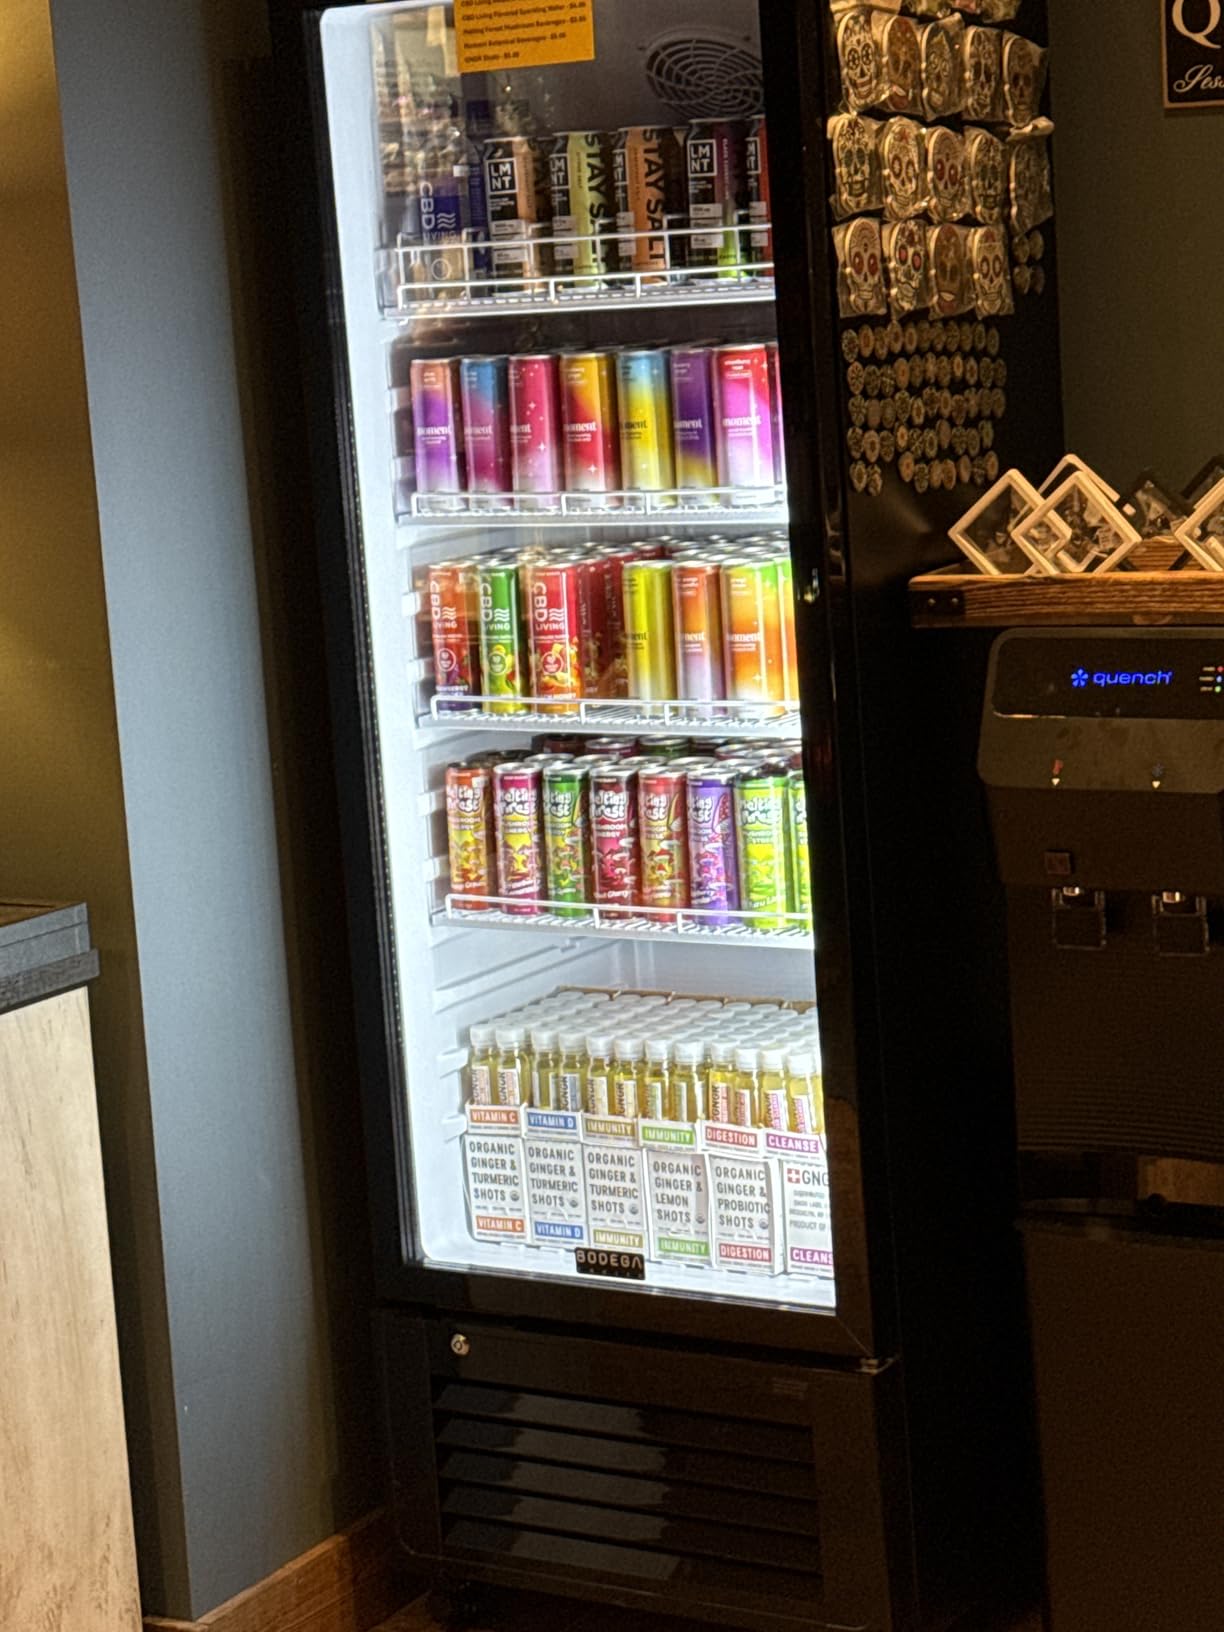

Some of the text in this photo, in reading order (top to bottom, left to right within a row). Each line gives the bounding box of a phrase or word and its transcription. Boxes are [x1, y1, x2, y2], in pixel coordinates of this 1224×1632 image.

[642, 128, 665, 198] STAY
[420, 181, 435, 230] CBD
[481, 582, 493, 623] CBD
[533, 582, 548, 623] CBD
[1092, 669, 1171, 687] quench
[471, 1108, 517, 1122] VITAMIN C
[528, 1113, 575, 1128] VITAMIN D
[587, 1118, 632, 1135] IMMUNITY
[644, 1127, 691, 1144] IMMUNITY
[706, 1127, 756, 1146] DIGESTION
[767, 1135, 817, 1152] CLEANSE
[469, 1141, 515, 1155] ORGANIC
[528, 1146, 575, 1161] ORGANIC
[471, 1155, 517, 1170] GINGER &
[587, 1151, 635, 1168] ORGANIC
[530, 1162, 576, 1177] GINGER &
[589, 1168, 637, 1183] GINGER &
[653, 1160, 701, 1176] ORGANIC
[715, 1166, 765, 1181] ORGANIC
[472, 1172, 519, 1187] TURMERIC
[531, 1177, 578, 1193] TURMERIC
[655, 1176, 703, 1192] GINGER &
[473, 1187, 507, 1201] SHOTS
[589, 1183, 639, 1200] TURMERIC
[716, 1182, 767, 1198] GINGER &
[532, 1193, 565, 1208] SHOTS
[591, 1199, 625, 1214] SHOTS
[655, 1192, 689, 1207] LEMON
[717, 1198, 770, 1215] PROBIOTIC
[477, 1216, 522, 1231] VITAMIN C
[656, 1208, 691, 1224] SHOTS
[719, 1214, 754, 1229] SHOTS
[536, 1222, 581, 1238] VITAMIN D
[594, 1230, 640, 1247] IMMUNITY
[659, 1238, 706, 1255] IMMUNITY
[576, 1249, 643, 1270] BODEGA
[719, 1243, 770, 1262] DIGESTION
